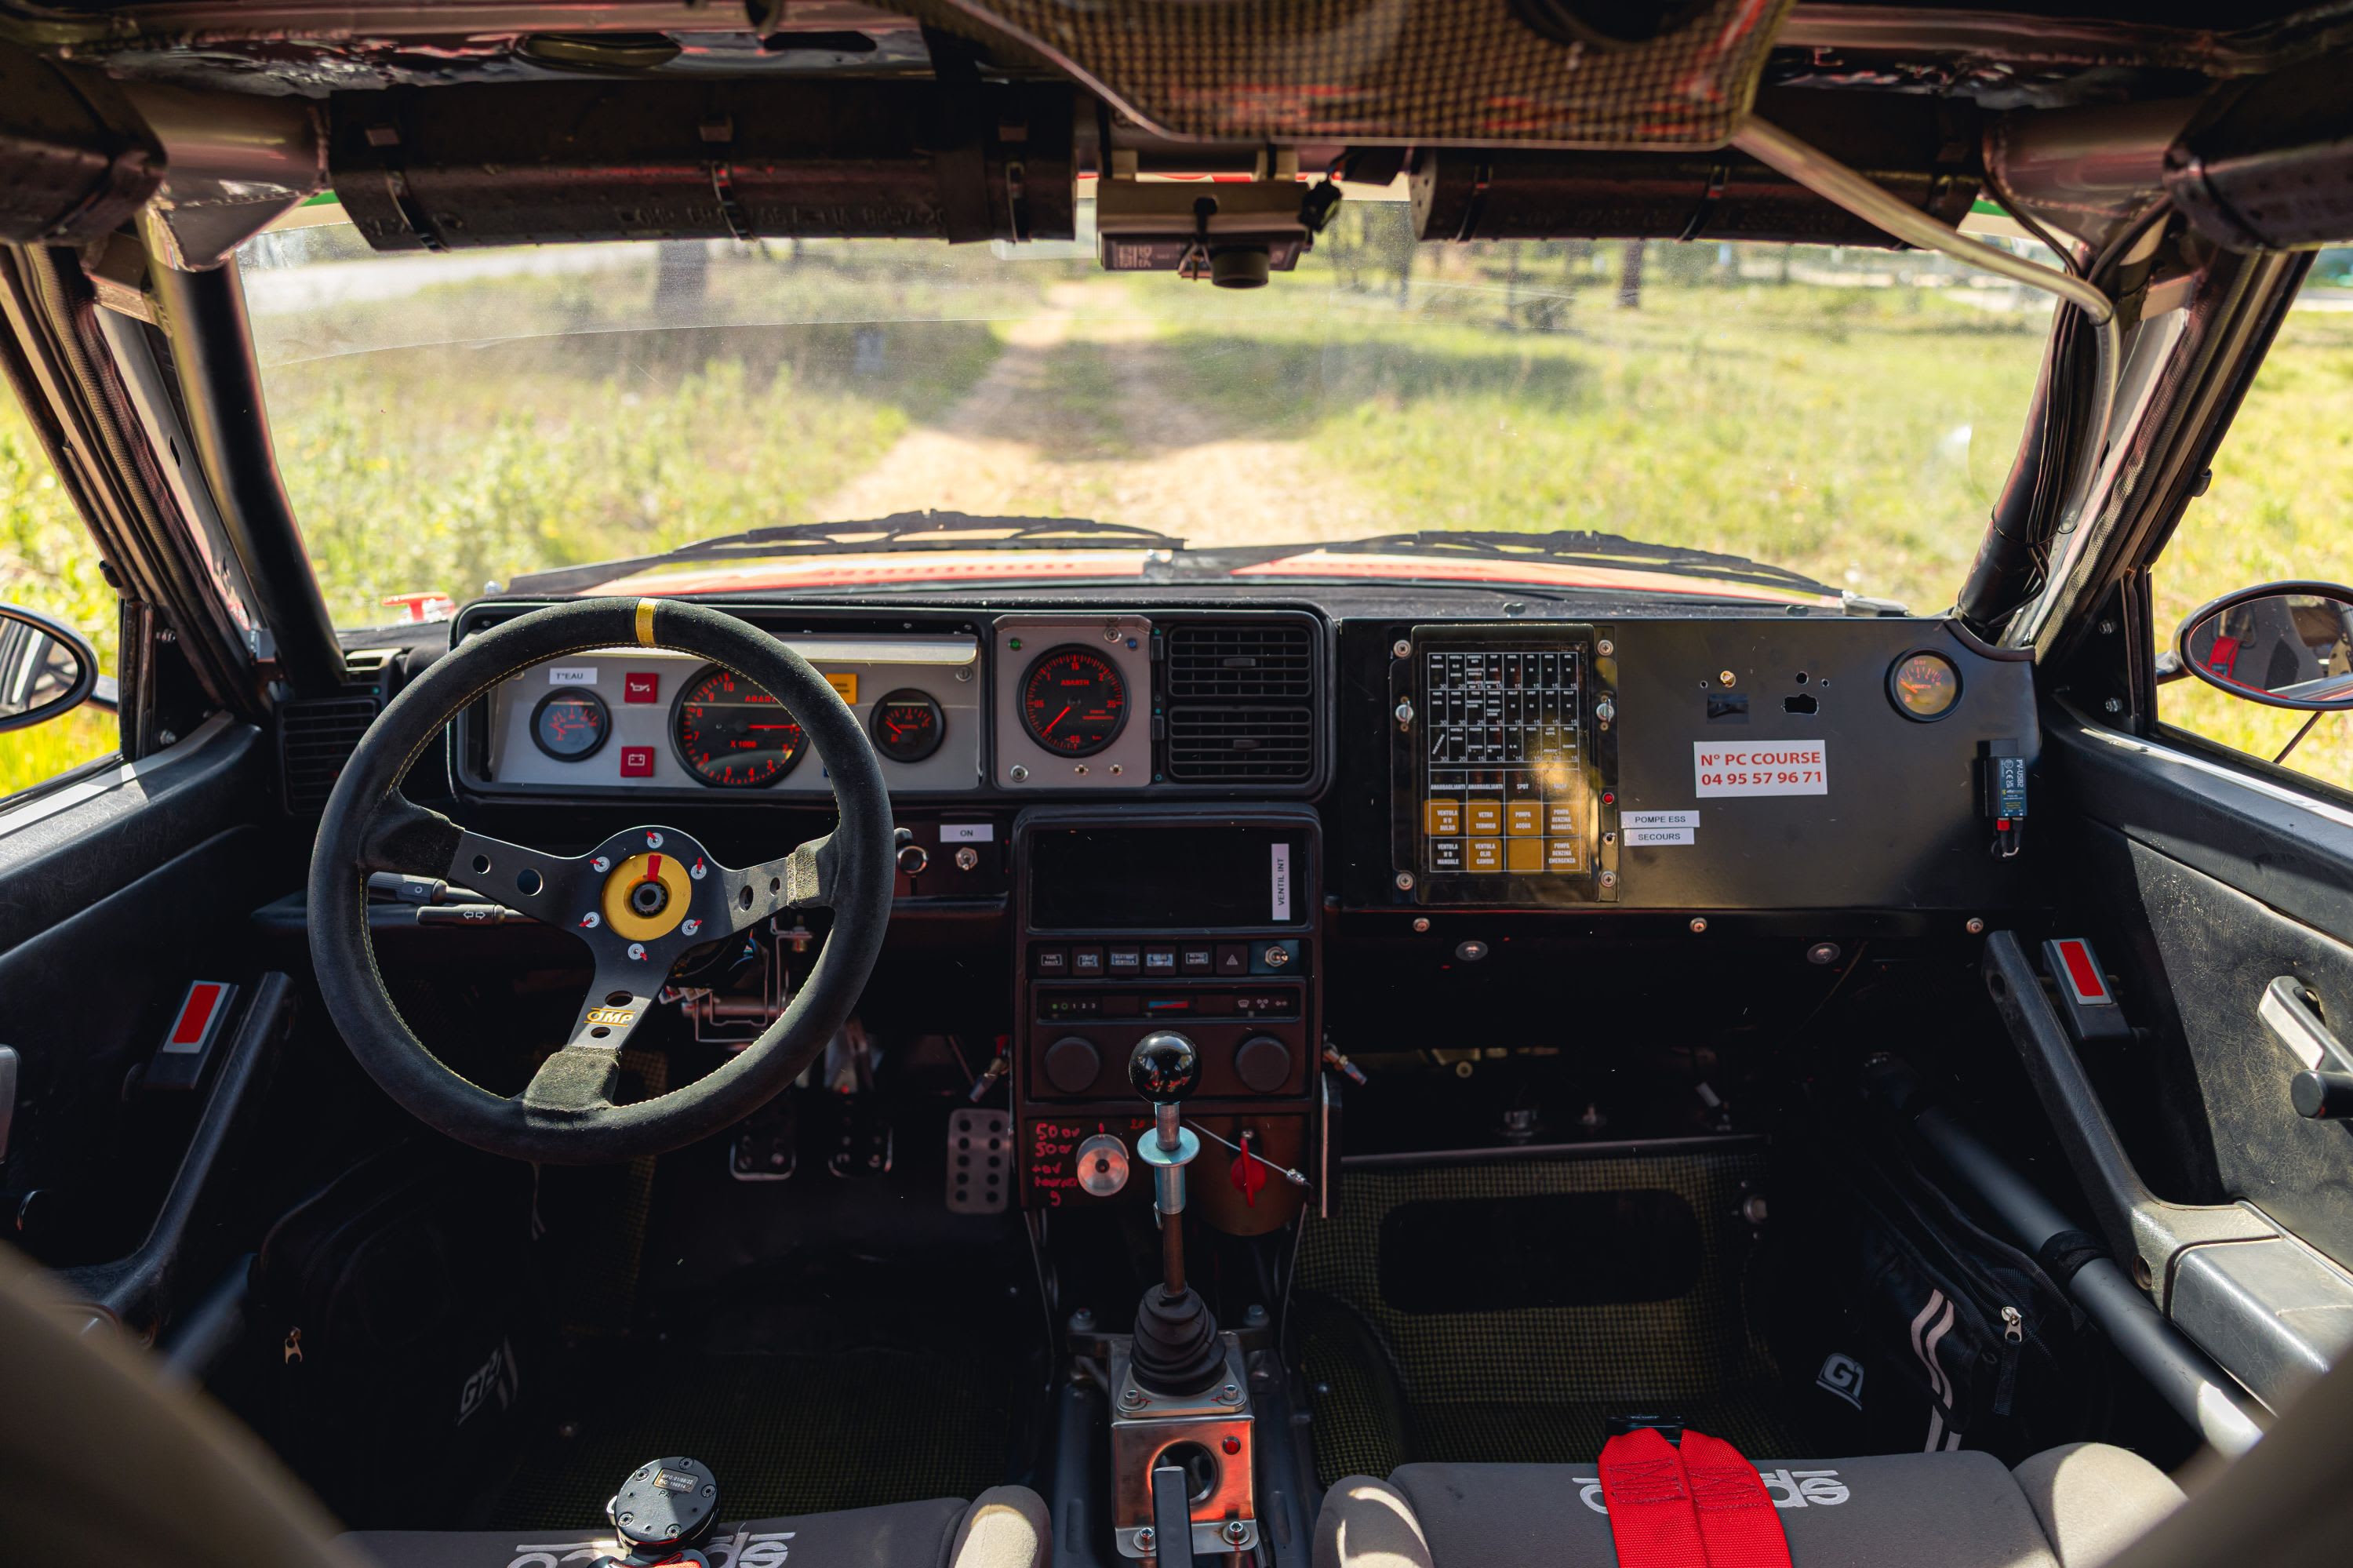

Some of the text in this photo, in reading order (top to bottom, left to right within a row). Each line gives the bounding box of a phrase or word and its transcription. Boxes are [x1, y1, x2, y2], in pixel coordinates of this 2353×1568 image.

[1700, 751, 1821, 766] N° PC COURSE
[1701, 771, 1821, 785] 04 95 57 96 71
[587, 1010, 634, 1024] OMP
[1035, 1122, 1058, 1141] 50
[1035, 1141, 1056, 1158] 50
[658, 1490, 678, 1500] PAT
